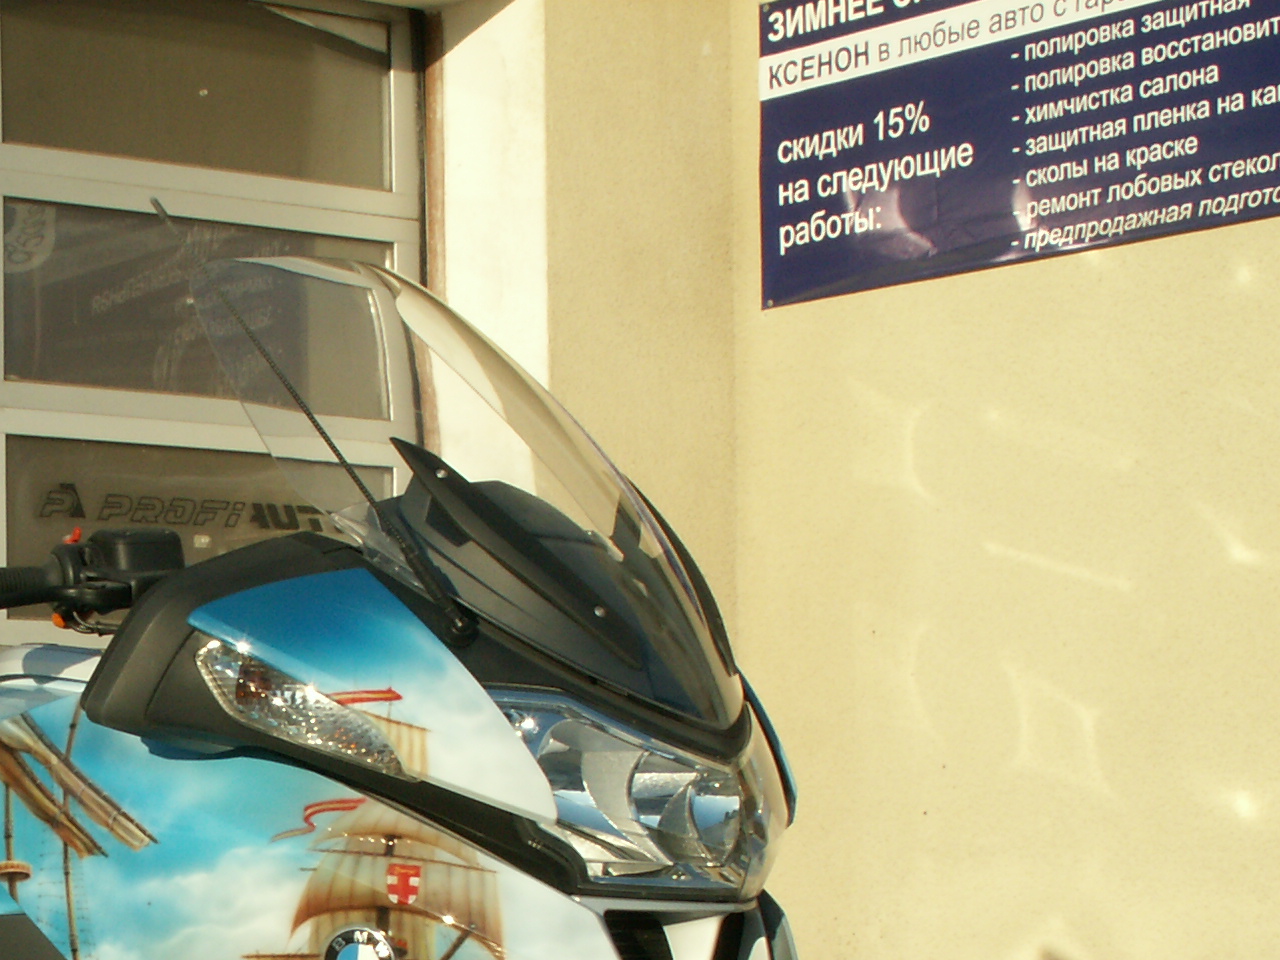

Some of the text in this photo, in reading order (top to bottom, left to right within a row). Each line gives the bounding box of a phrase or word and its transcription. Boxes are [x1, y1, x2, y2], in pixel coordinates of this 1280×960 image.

[768, 0, 884, 42] ЗИМНЕЕ
[768, 41, 870, 90] КСЕНОН
[878, 42, 890, 62] в
[898, 19, 980, 58] любые
[988, 3, 1044, 34] авто
[1025, 19, 1134, 61] полировка
[1025, 16, 1280, 93] полировка восстановит
[1025, 64, 1219, 124] химчистка салона
[1025, 84, 1280, 156] защитная пленка на ка
[777, 101, 930, 164] скидки 15%
[778, 142, 974, 206] на следующие
[1026, 135, 1198, 187] сколы на краске
[1026, 188, 1102, 219] ремонт
[1107, 173, 1202, 203] лобовых
[779, 206, 882, 256] работы:
[1024, 202, 1193, 252] предпродажная
